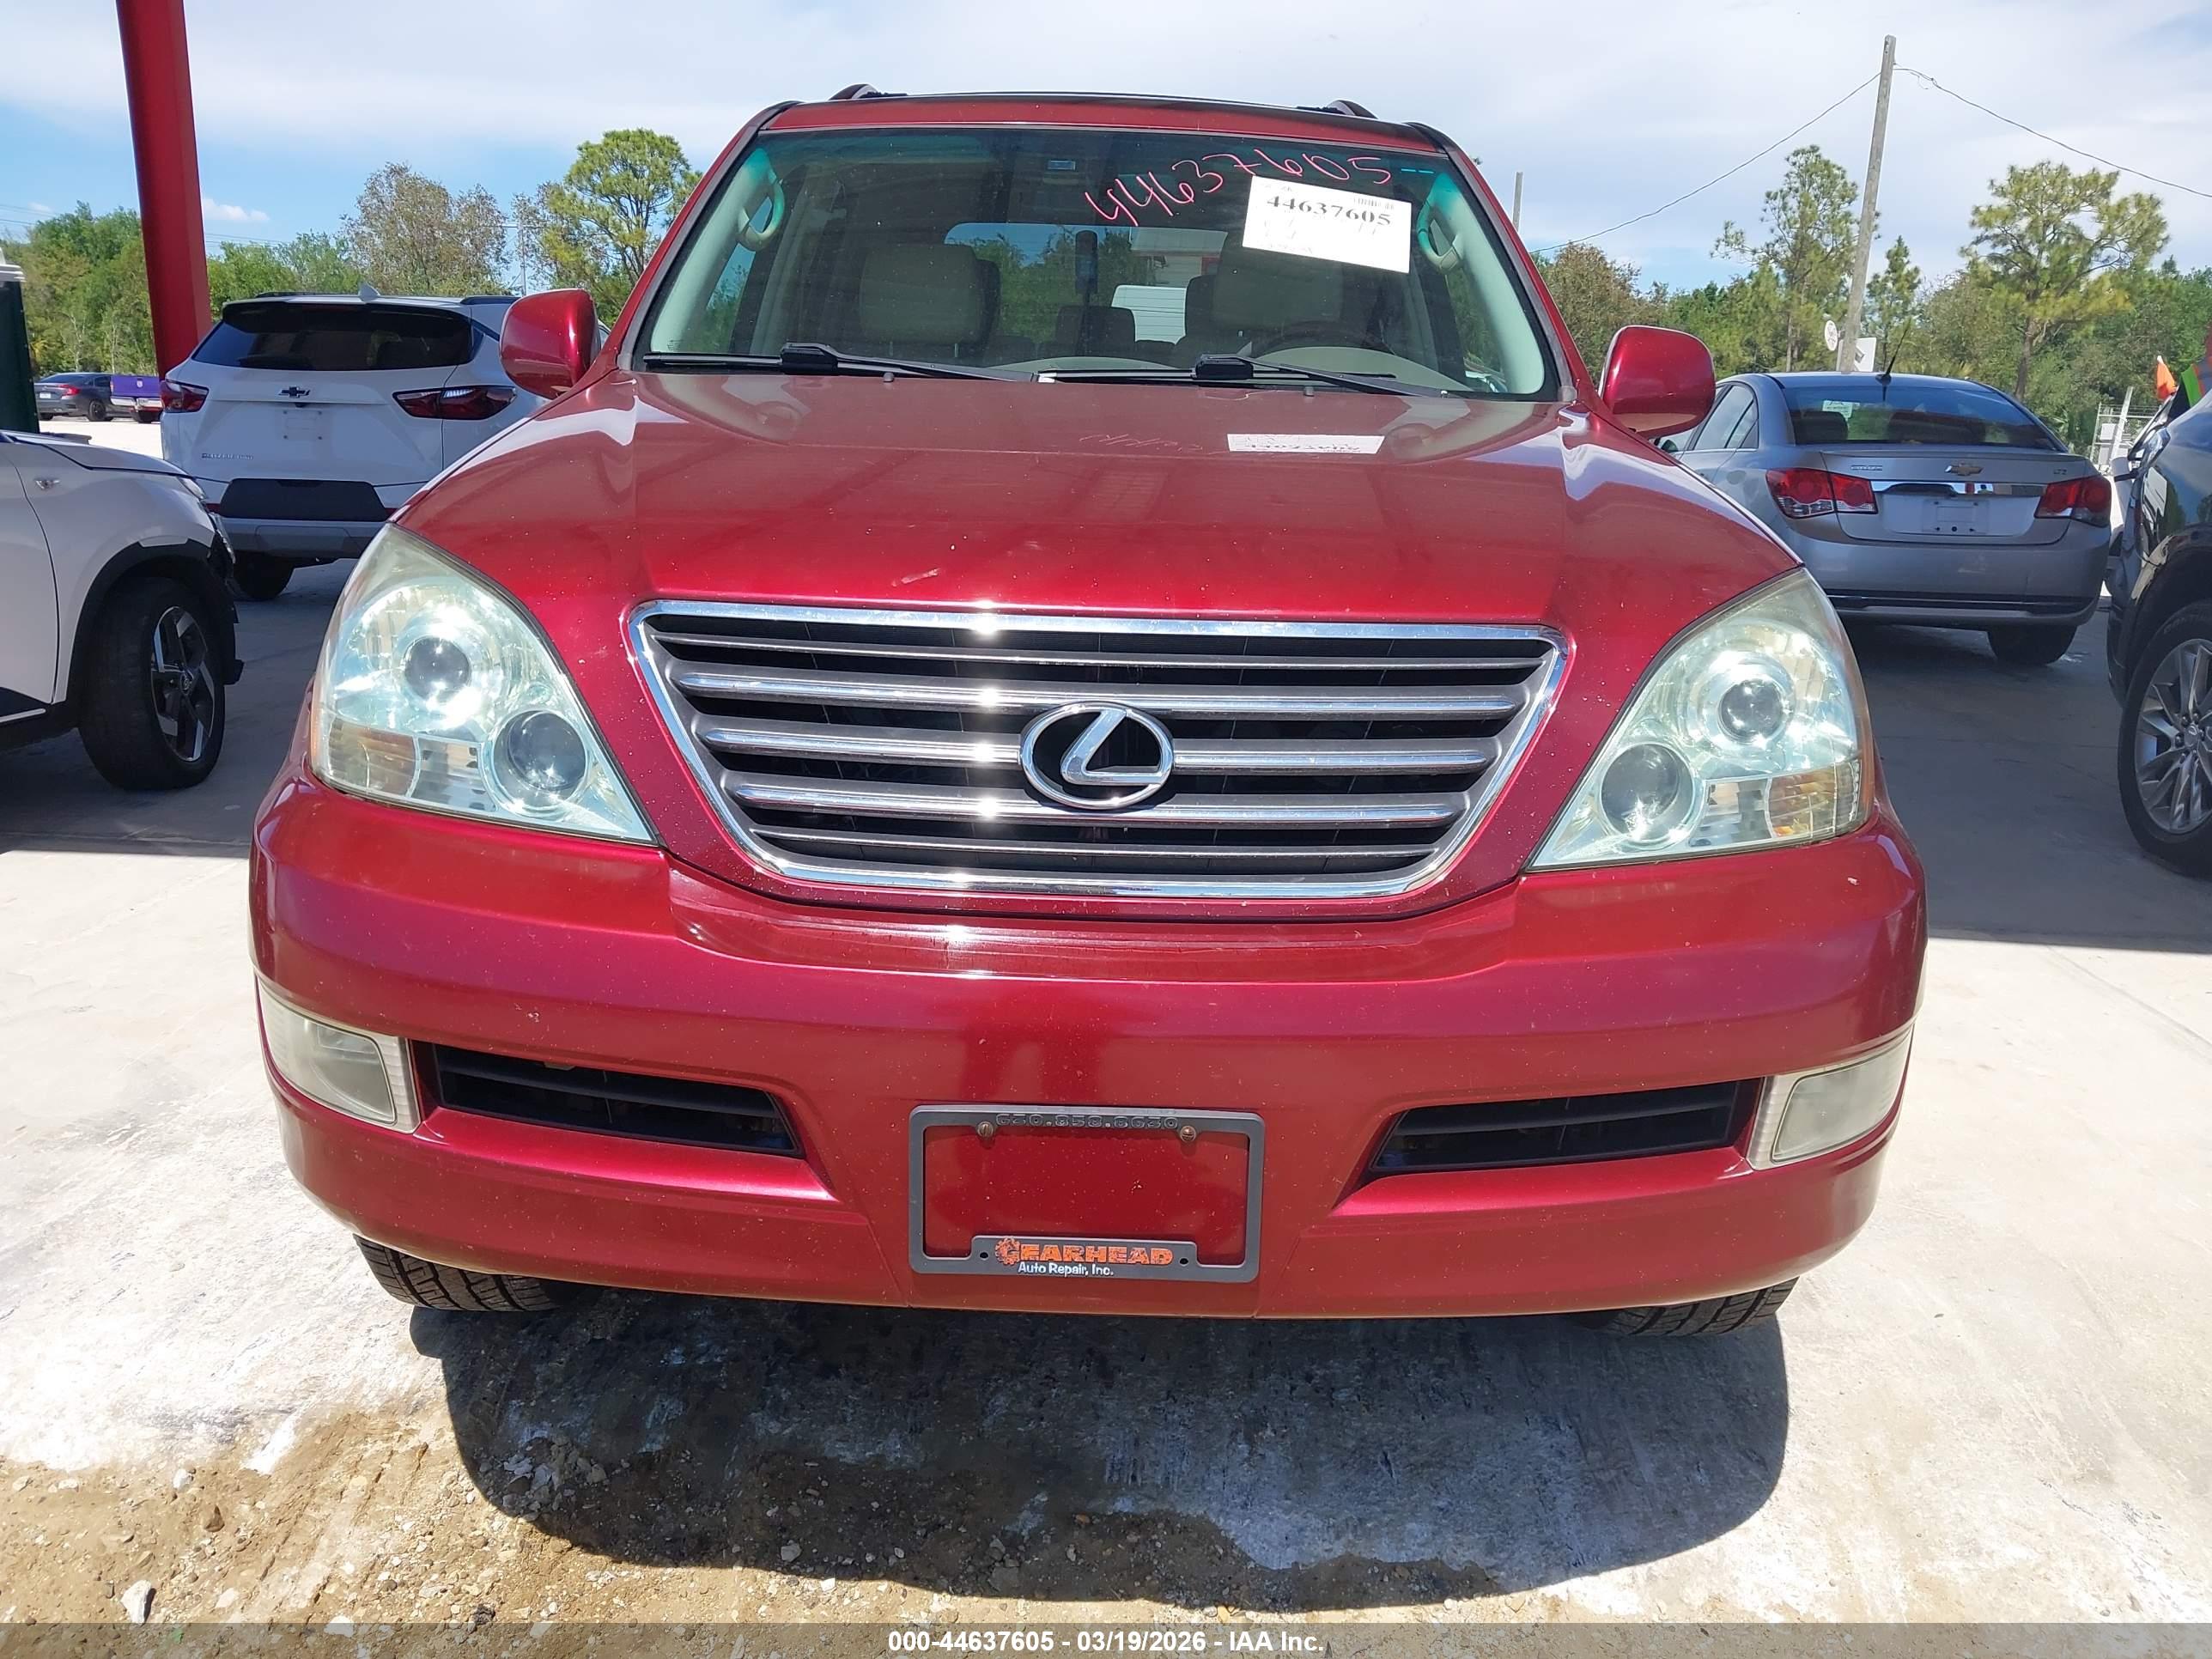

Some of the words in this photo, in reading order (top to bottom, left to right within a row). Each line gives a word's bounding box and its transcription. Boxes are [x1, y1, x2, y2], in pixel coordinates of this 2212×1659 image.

[1085, 148, 1392, 226] 44637605
[1267, 195, 1391, 226] 44637605
[994, 1237, 1174, 1265] GEARHEAD
[1018, 1262, 1047, 1274] Auto
[1048, 1264, 1089, 1277] Repair,
[1091, 1264, 1115, 1276] Inc.
